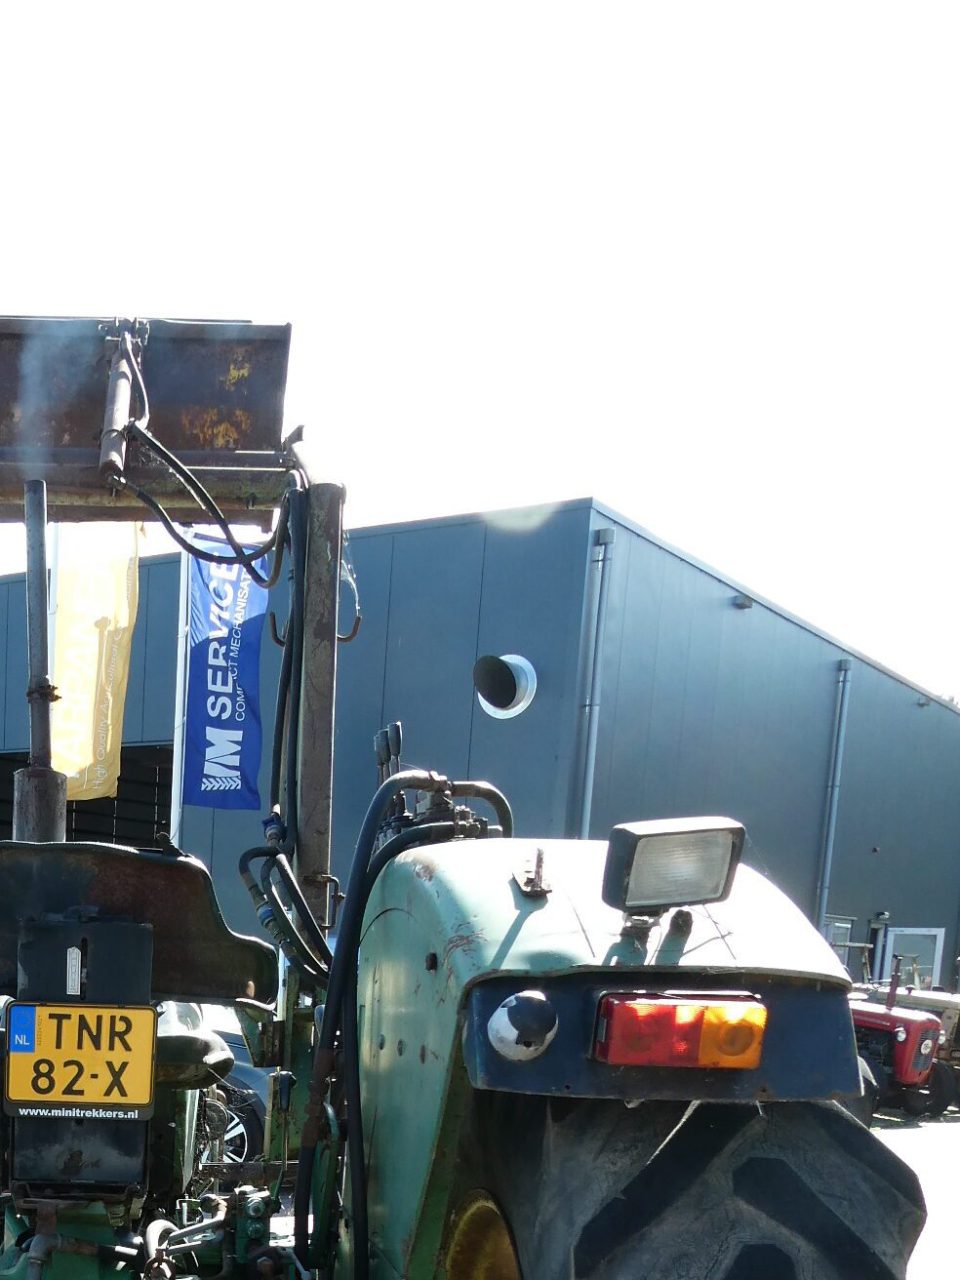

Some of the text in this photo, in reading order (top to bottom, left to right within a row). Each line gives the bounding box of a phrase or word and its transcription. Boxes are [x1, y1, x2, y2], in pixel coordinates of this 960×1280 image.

[207, 552, 240, 720] SERVICE
[227, 659, 246, 721] COMCT
[14, 1034, 30, 1046] NL
[48, 1012, 133, 1052] TNR
[30, 1058, 129, 1098] 82-X
[18, 1107, 140, 1119] www.minitrekkers.nl
